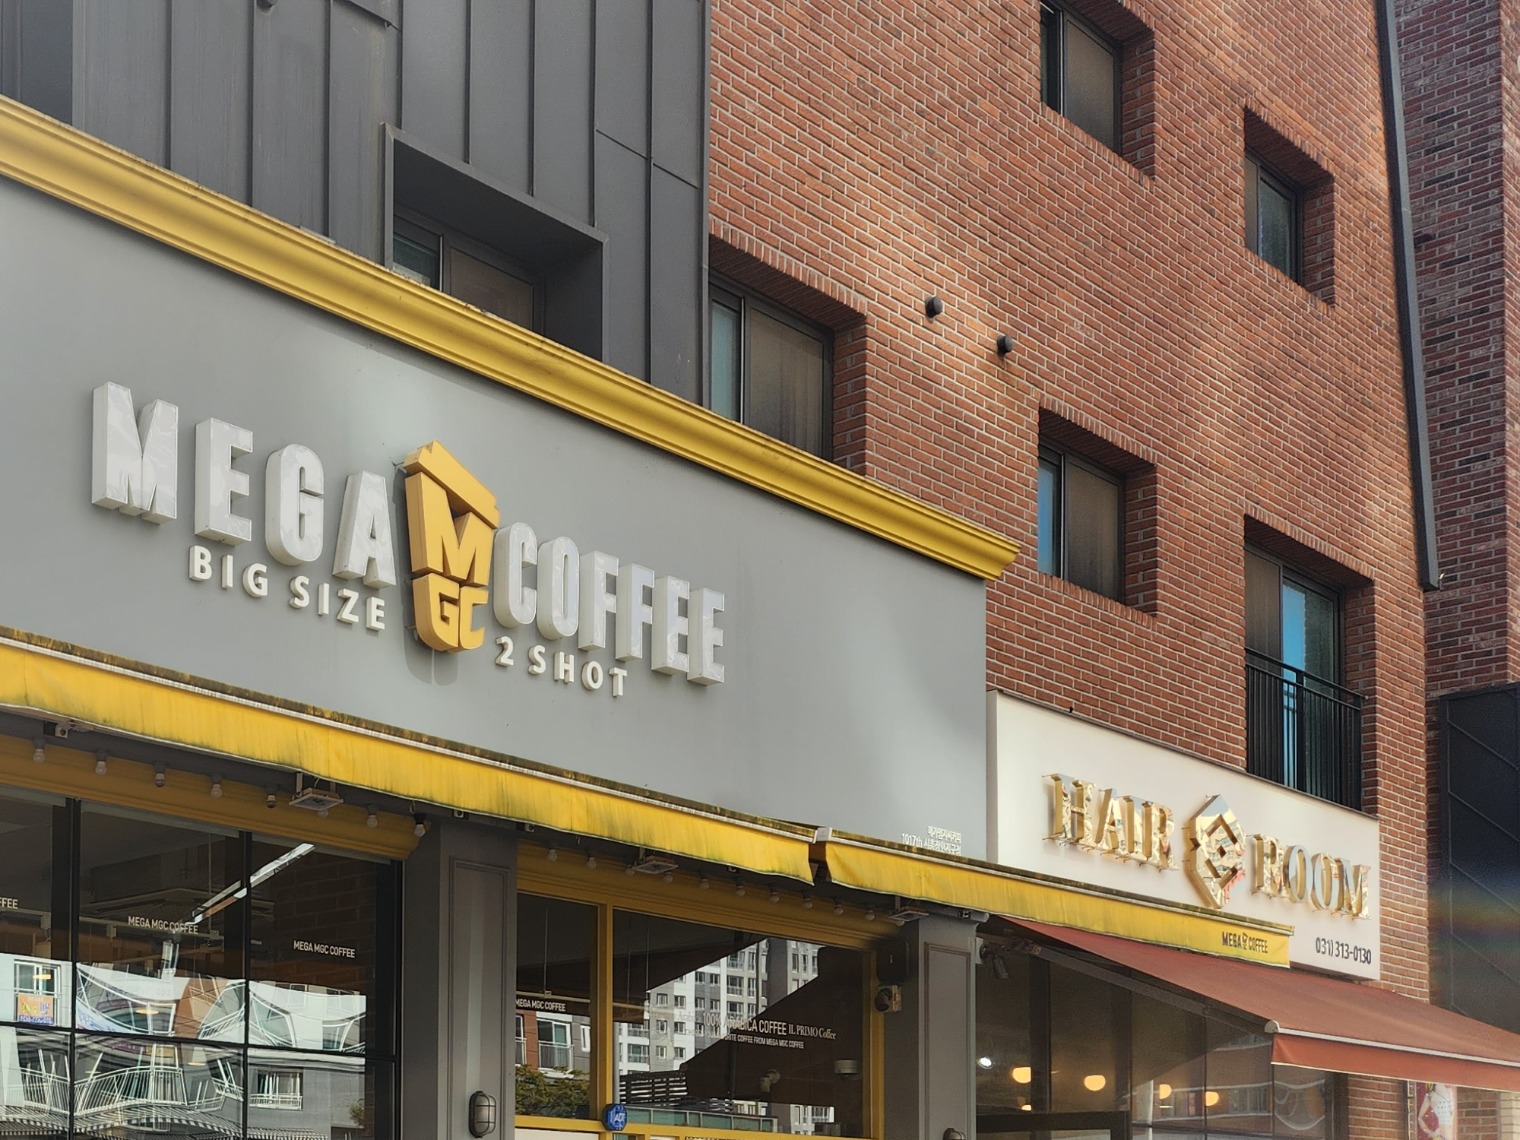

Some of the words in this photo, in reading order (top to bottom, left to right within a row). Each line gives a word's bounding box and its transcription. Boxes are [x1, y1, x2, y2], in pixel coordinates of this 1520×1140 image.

[91, 380, 396, 588] MEGA
[493, 522, 726, 687] COFFEE
[189, 544, 270, 598] BIG
[288, 574, 386, 632] SIZE
[495, 636, 514, 668] 2
[528, 644, 628, 698] SHOT
[1042, 772, 1179, 873] HAIR
[1251, 833, 1373, 921] ROOM
[128, 915, 150, 929] MEGA
[151, 918, 169, 931] MGC
[169, 921, 198, 935] COFFEE
[293, 940, 313, 952] MEGA
[314, 942, 329, 955] MGC
[330, 945, 356, 959] COFFEE
[1222, 931, 1242, 949] MEGA
[1248, 936, 1268, 954] COFFEE
[532, 1000, 545, 1010] MGC
[545, 1001, 566, 1012] COFFEE
[758, 1019, 787, 1036] COFFEE
[796, 1024, 818, 1039] PRIMO
[818, 1026, 837, 1040] Coffee
